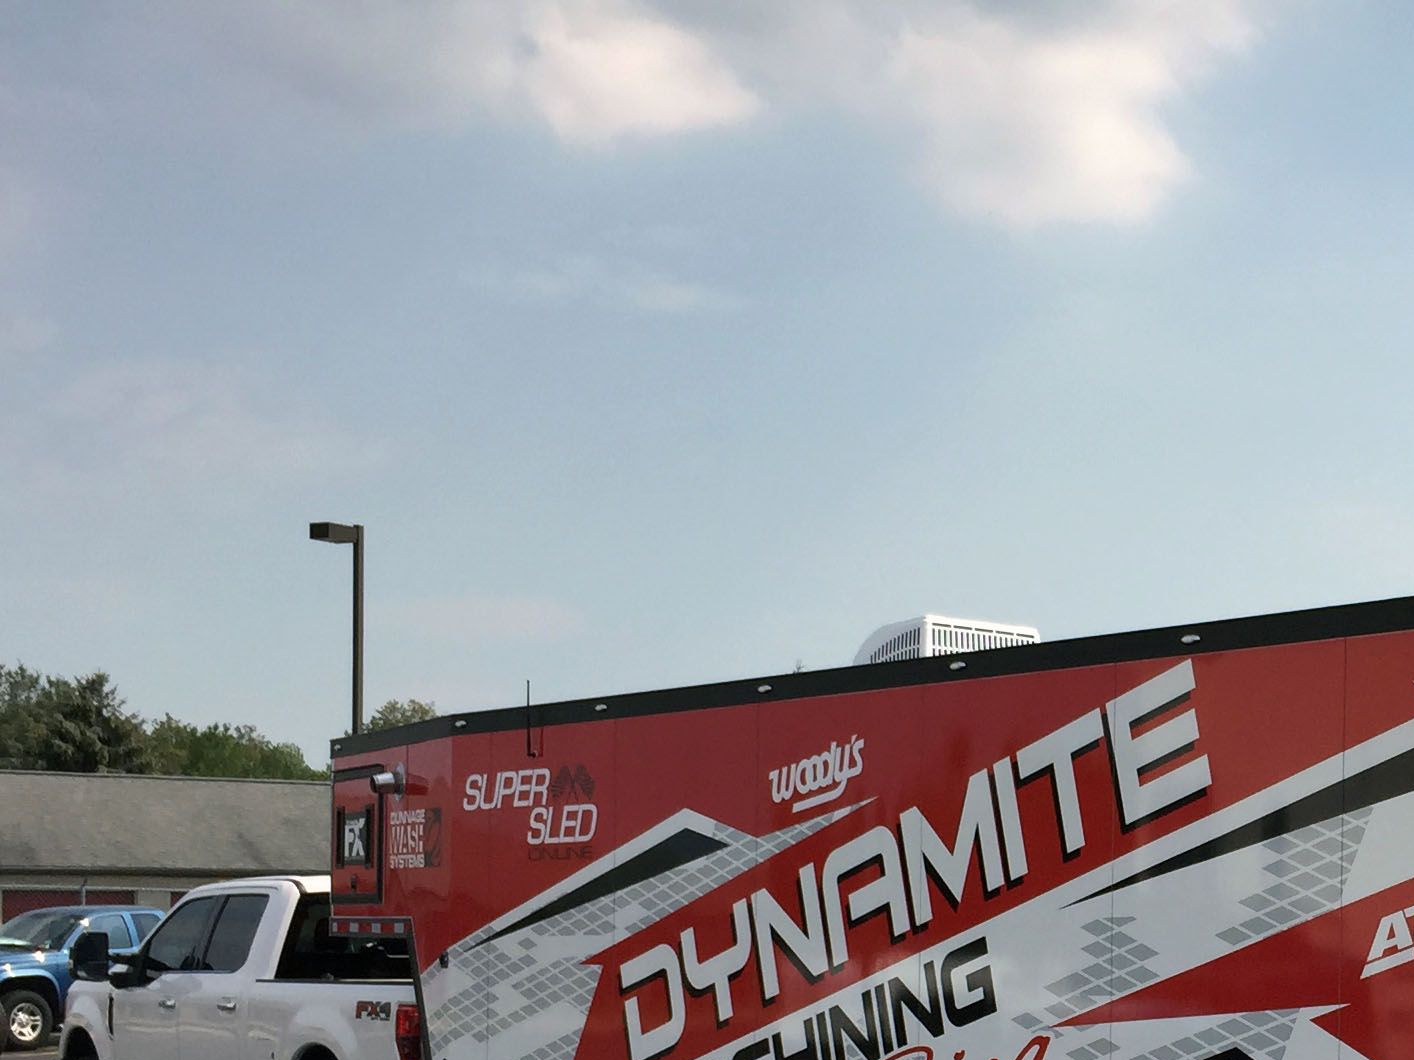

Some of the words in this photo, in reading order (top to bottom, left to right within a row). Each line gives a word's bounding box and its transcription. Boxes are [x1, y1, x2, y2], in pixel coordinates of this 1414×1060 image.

[463, 767, 550, 811] SUPER
[389, 808, 426, 825] DUNNAGE
[527, 803, 598, 845] SLED
[344, 818, 366, 857] FX
[389, 854, 425, 869] SYSTEMS
[528, 846, 594, 861] ONLINE
[356, 1000, 392, 1019] FX4
